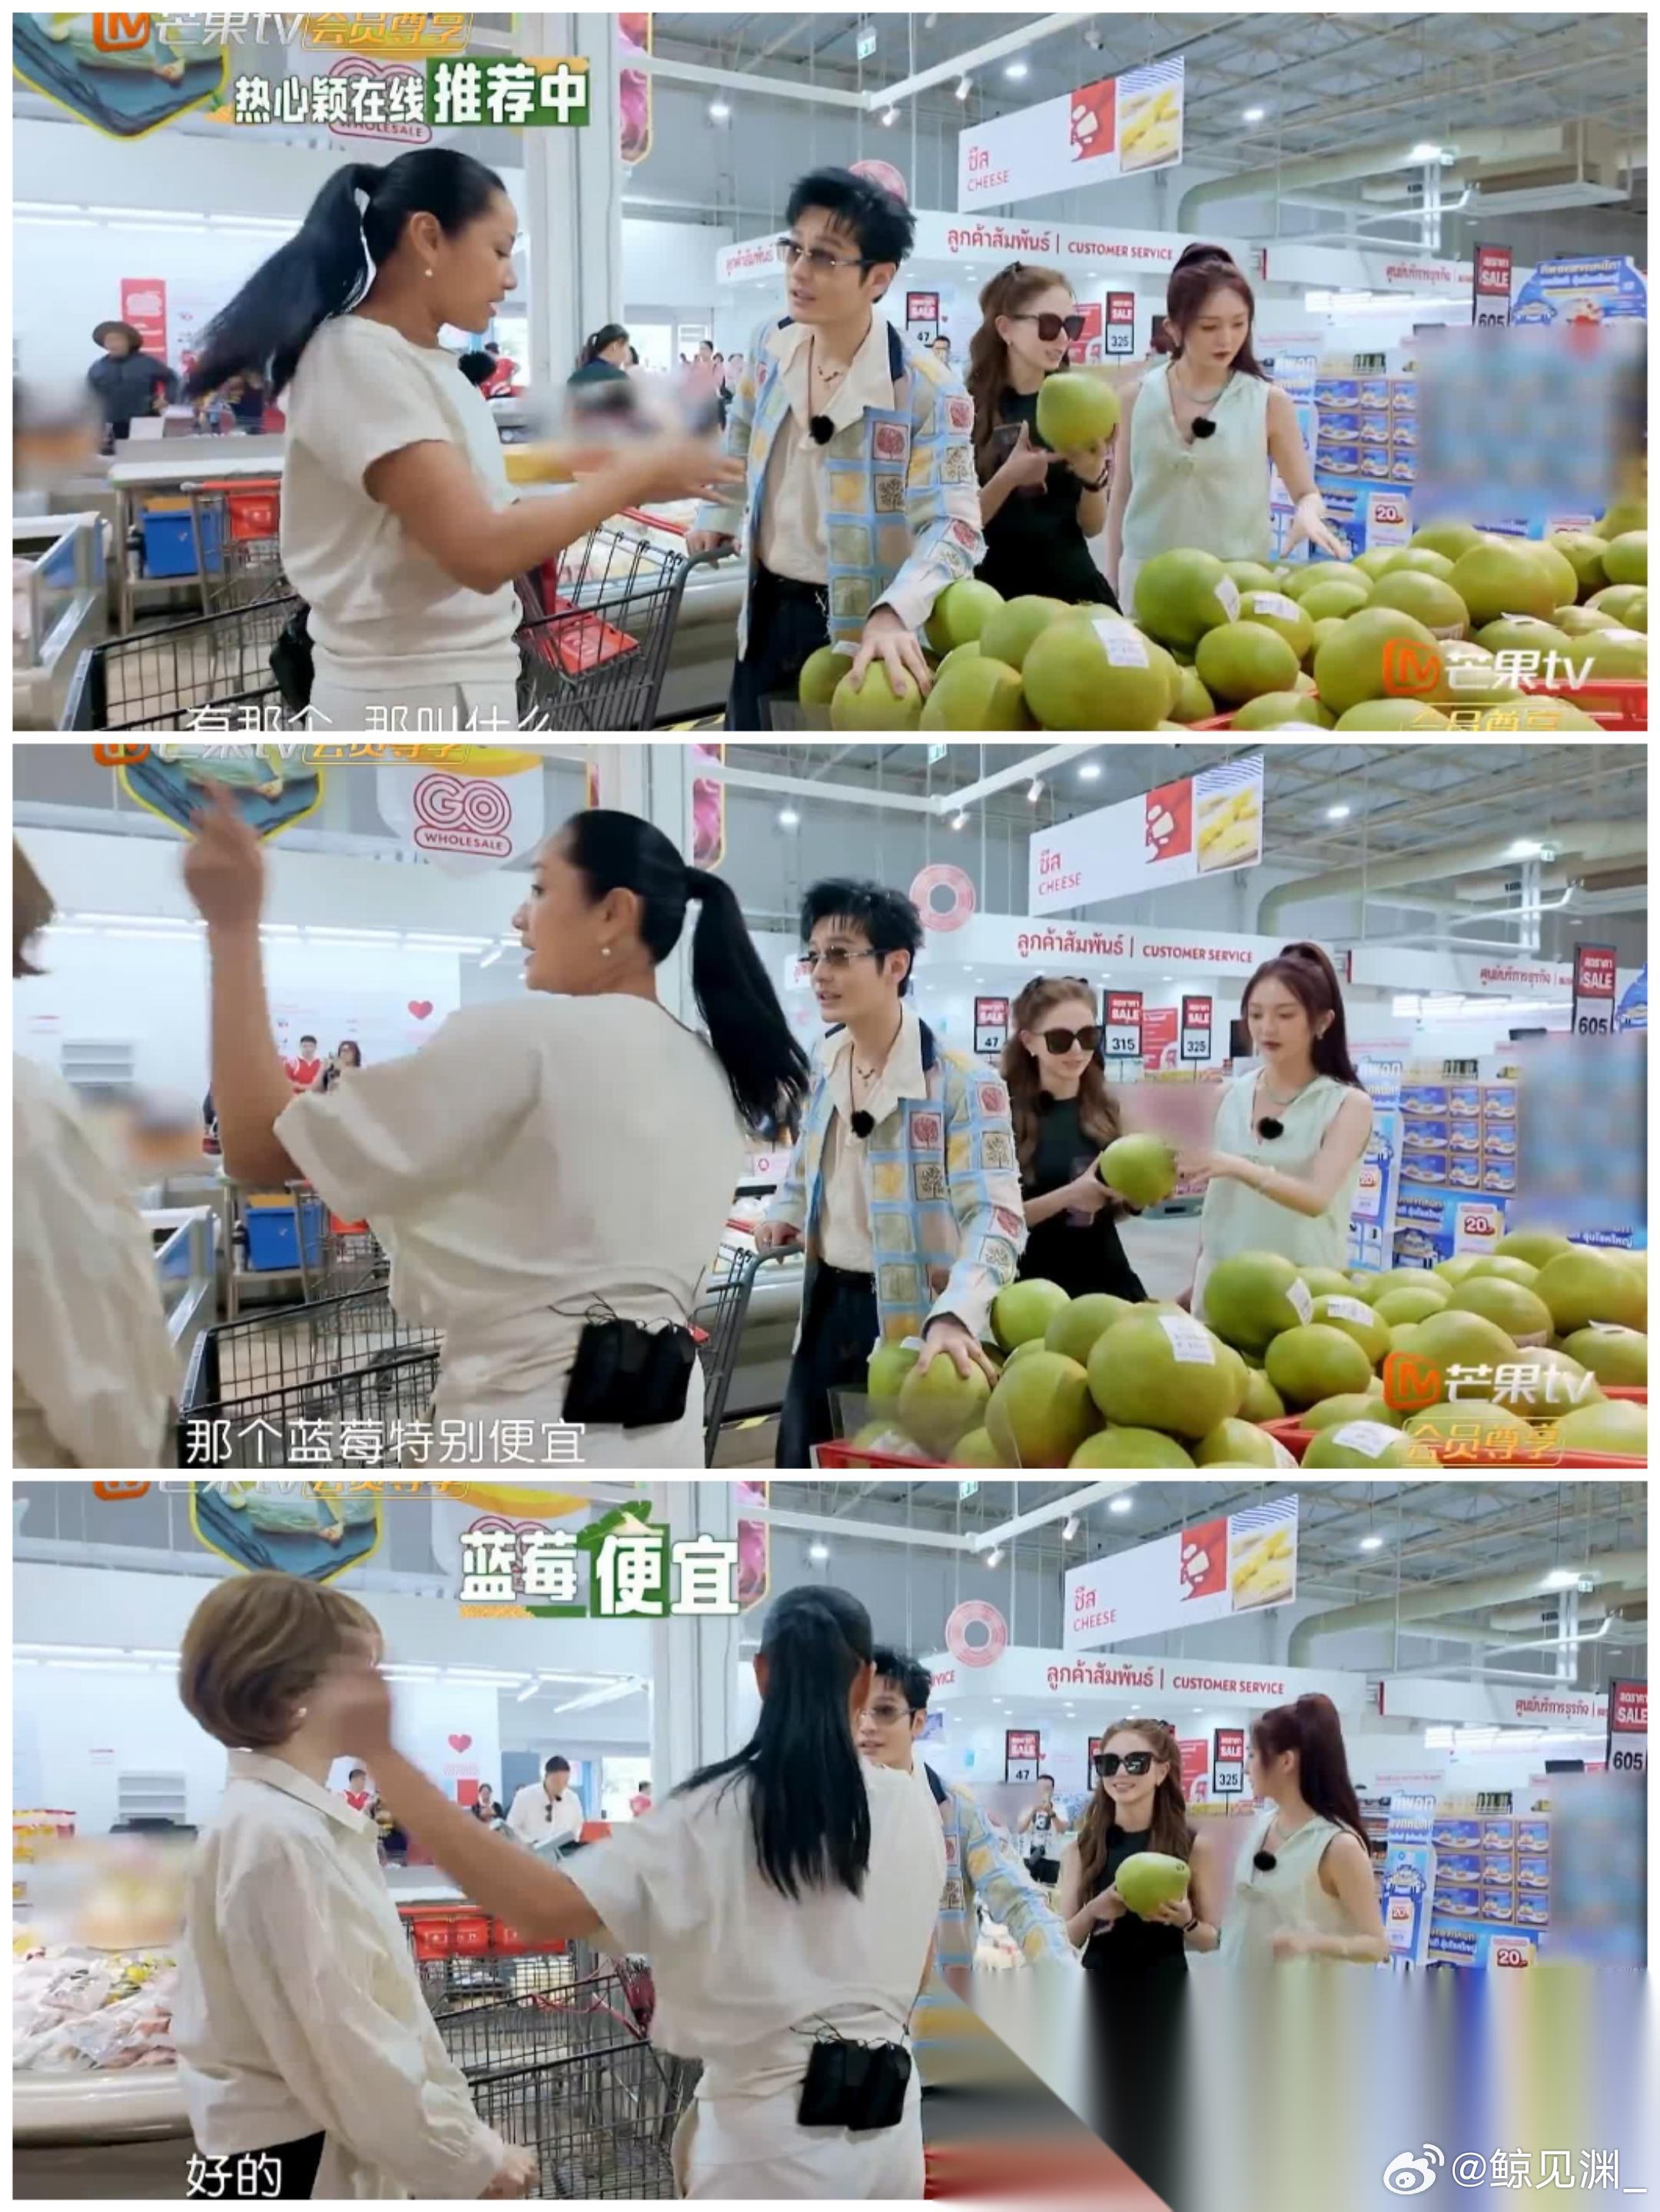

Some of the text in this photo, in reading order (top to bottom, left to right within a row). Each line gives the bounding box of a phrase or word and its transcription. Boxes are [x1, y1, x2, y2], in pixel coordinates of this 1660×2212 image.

[967, 171, 1011, 191] CHEESE
[1067, 241, 1127, 257] CUSTOMER
[1130, 246, 1173, 260] SERVICE
[1480, 270, 1509, 287] SALE
[1111, 308, 1133, 320] SALE
[917, 331, 930, 342] 47
[1111, 334, 1130, 347] 325
[413, 773, 512, 836] GO
[424, 831, 503, 851] WHOLESALE
[1039, 849, 1061, 874] ชีส
[1038, 873, 1082, 895] CHEESE
[1143, 945, 1206, 960] CUSTOMER
[1208, 949, 1253, 963] SERVICE
[1582, 971, 1613, 989] SALE
[979, 1012, 1005, 1023] SALE
[1111, 1008, 1140, 1020] SALE
[1188, 1013, 1210, 1025] SALE
[1579, 1016, 1608, 1035] 605
[984, 1037, 999, 1048] 47
[1112, 1037, 1135, 1052] 315
[1187, 1041, 1207, 1053] 325
[1074, 1586, 1096, 1611] ชีส
[1074, 1609, 1117, 1632] CHEESE
[1047, 1659, 1284, 1695] ลูกค้าสัมพันธ์ CUSTOMER SERVICE
[1617, 1706, 1648, 1723] SALE
[1011, 1744, 1036, 1755] SALE
[1220, 1746, 1243, 1757] SALE
[1613, 1751, 1643, 1771] 605
[1015, 1769, 1030, 1780] 47
[1219, 1773, 1238, 1786] 325
